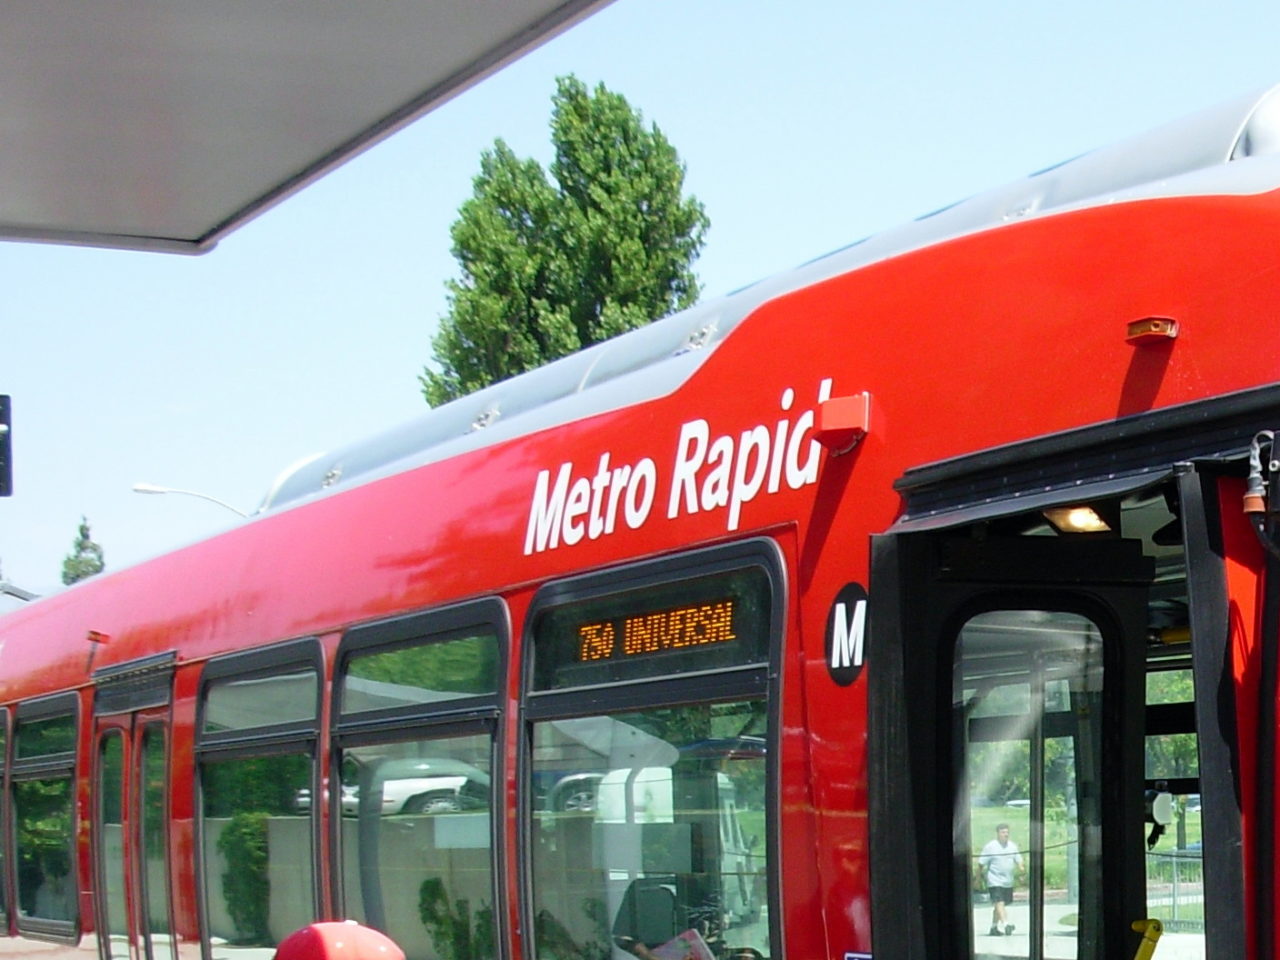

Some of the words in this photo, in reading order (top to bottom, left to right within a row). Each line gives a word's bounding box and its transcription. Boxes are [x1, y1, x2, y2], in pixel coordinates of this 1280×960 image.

[524, 452, 656, 555] Metro
[668, 378, 833, 531] Rapid
[579, 622, 615, 662] 750
[623, 601, 737, 655] UNIVERSAL
[831, 600, 867, 668] M
